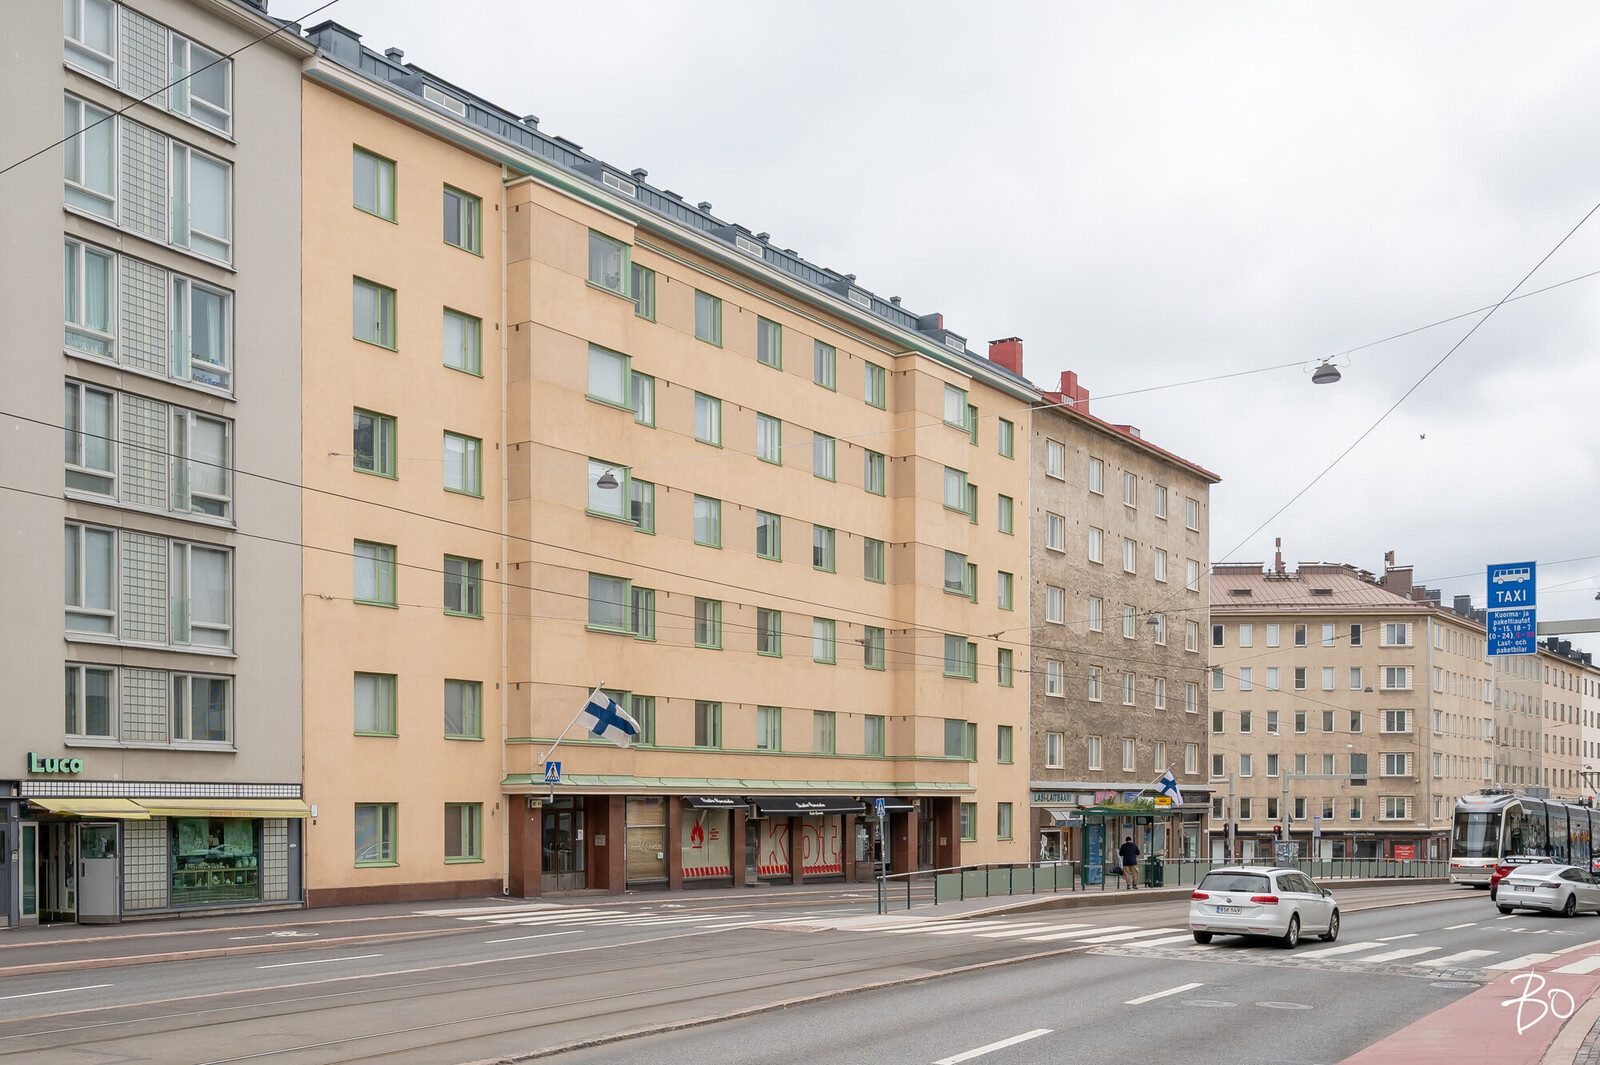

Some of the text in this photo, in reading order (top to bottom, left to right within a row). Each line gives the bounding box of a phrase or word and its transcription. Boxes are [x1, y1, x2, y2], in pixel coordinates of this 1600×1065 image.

[1496, 589, 1526, 603] TAXI
[1523, 610, 1530, 618] ja
[1493, 617, 1531, 626] pakettiautot
[28, 752, 84, 774] Luca
